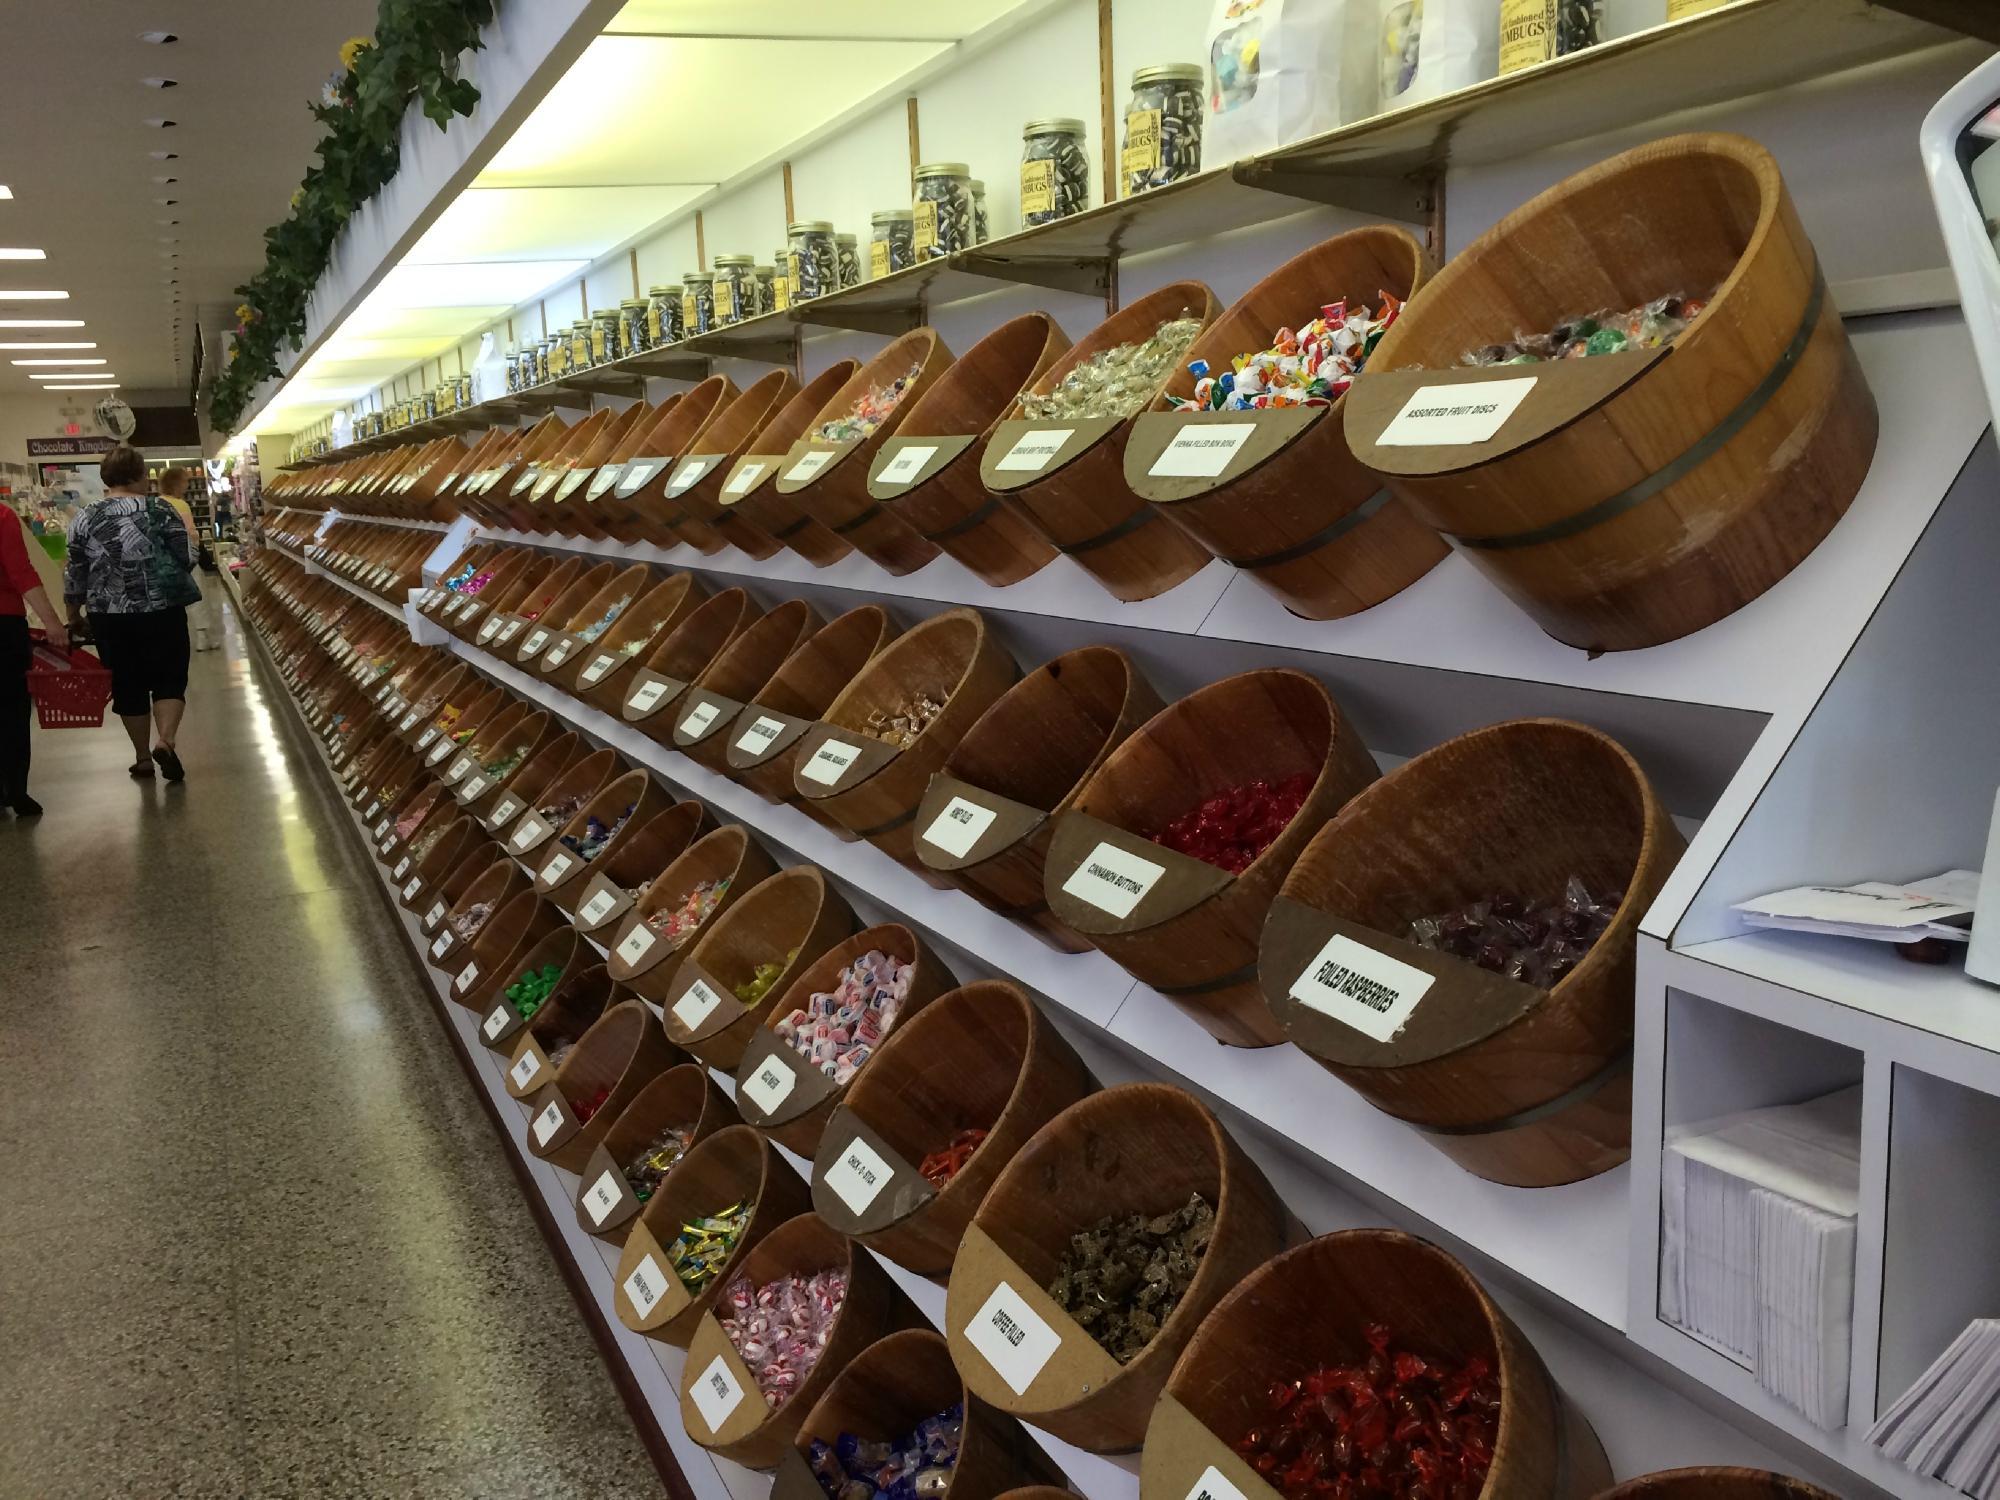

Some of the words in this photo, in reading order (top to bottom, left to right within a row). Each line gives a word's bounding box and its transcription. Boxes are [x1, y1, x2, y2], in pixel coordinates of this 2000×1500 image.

[1406, 407, 1449, 418] ASSORTED
[1446, 405, 1474, 416] FRUIT
[1471, 403, 1499, 415] DISCS
[31, 441, 74, 453] Chocolate
[1087, 863, 1119, 884] CINNAMON
[1114, 875, 1143, 895] BUTTONS
[1313, 960, 1350, 990] FOILED
[1338, 971, 1400, 1014] RASPBERRIES
[992, 1308, 1013, 1335] COFFEE
[1004, 1322, 1026, 1347] FILLED
